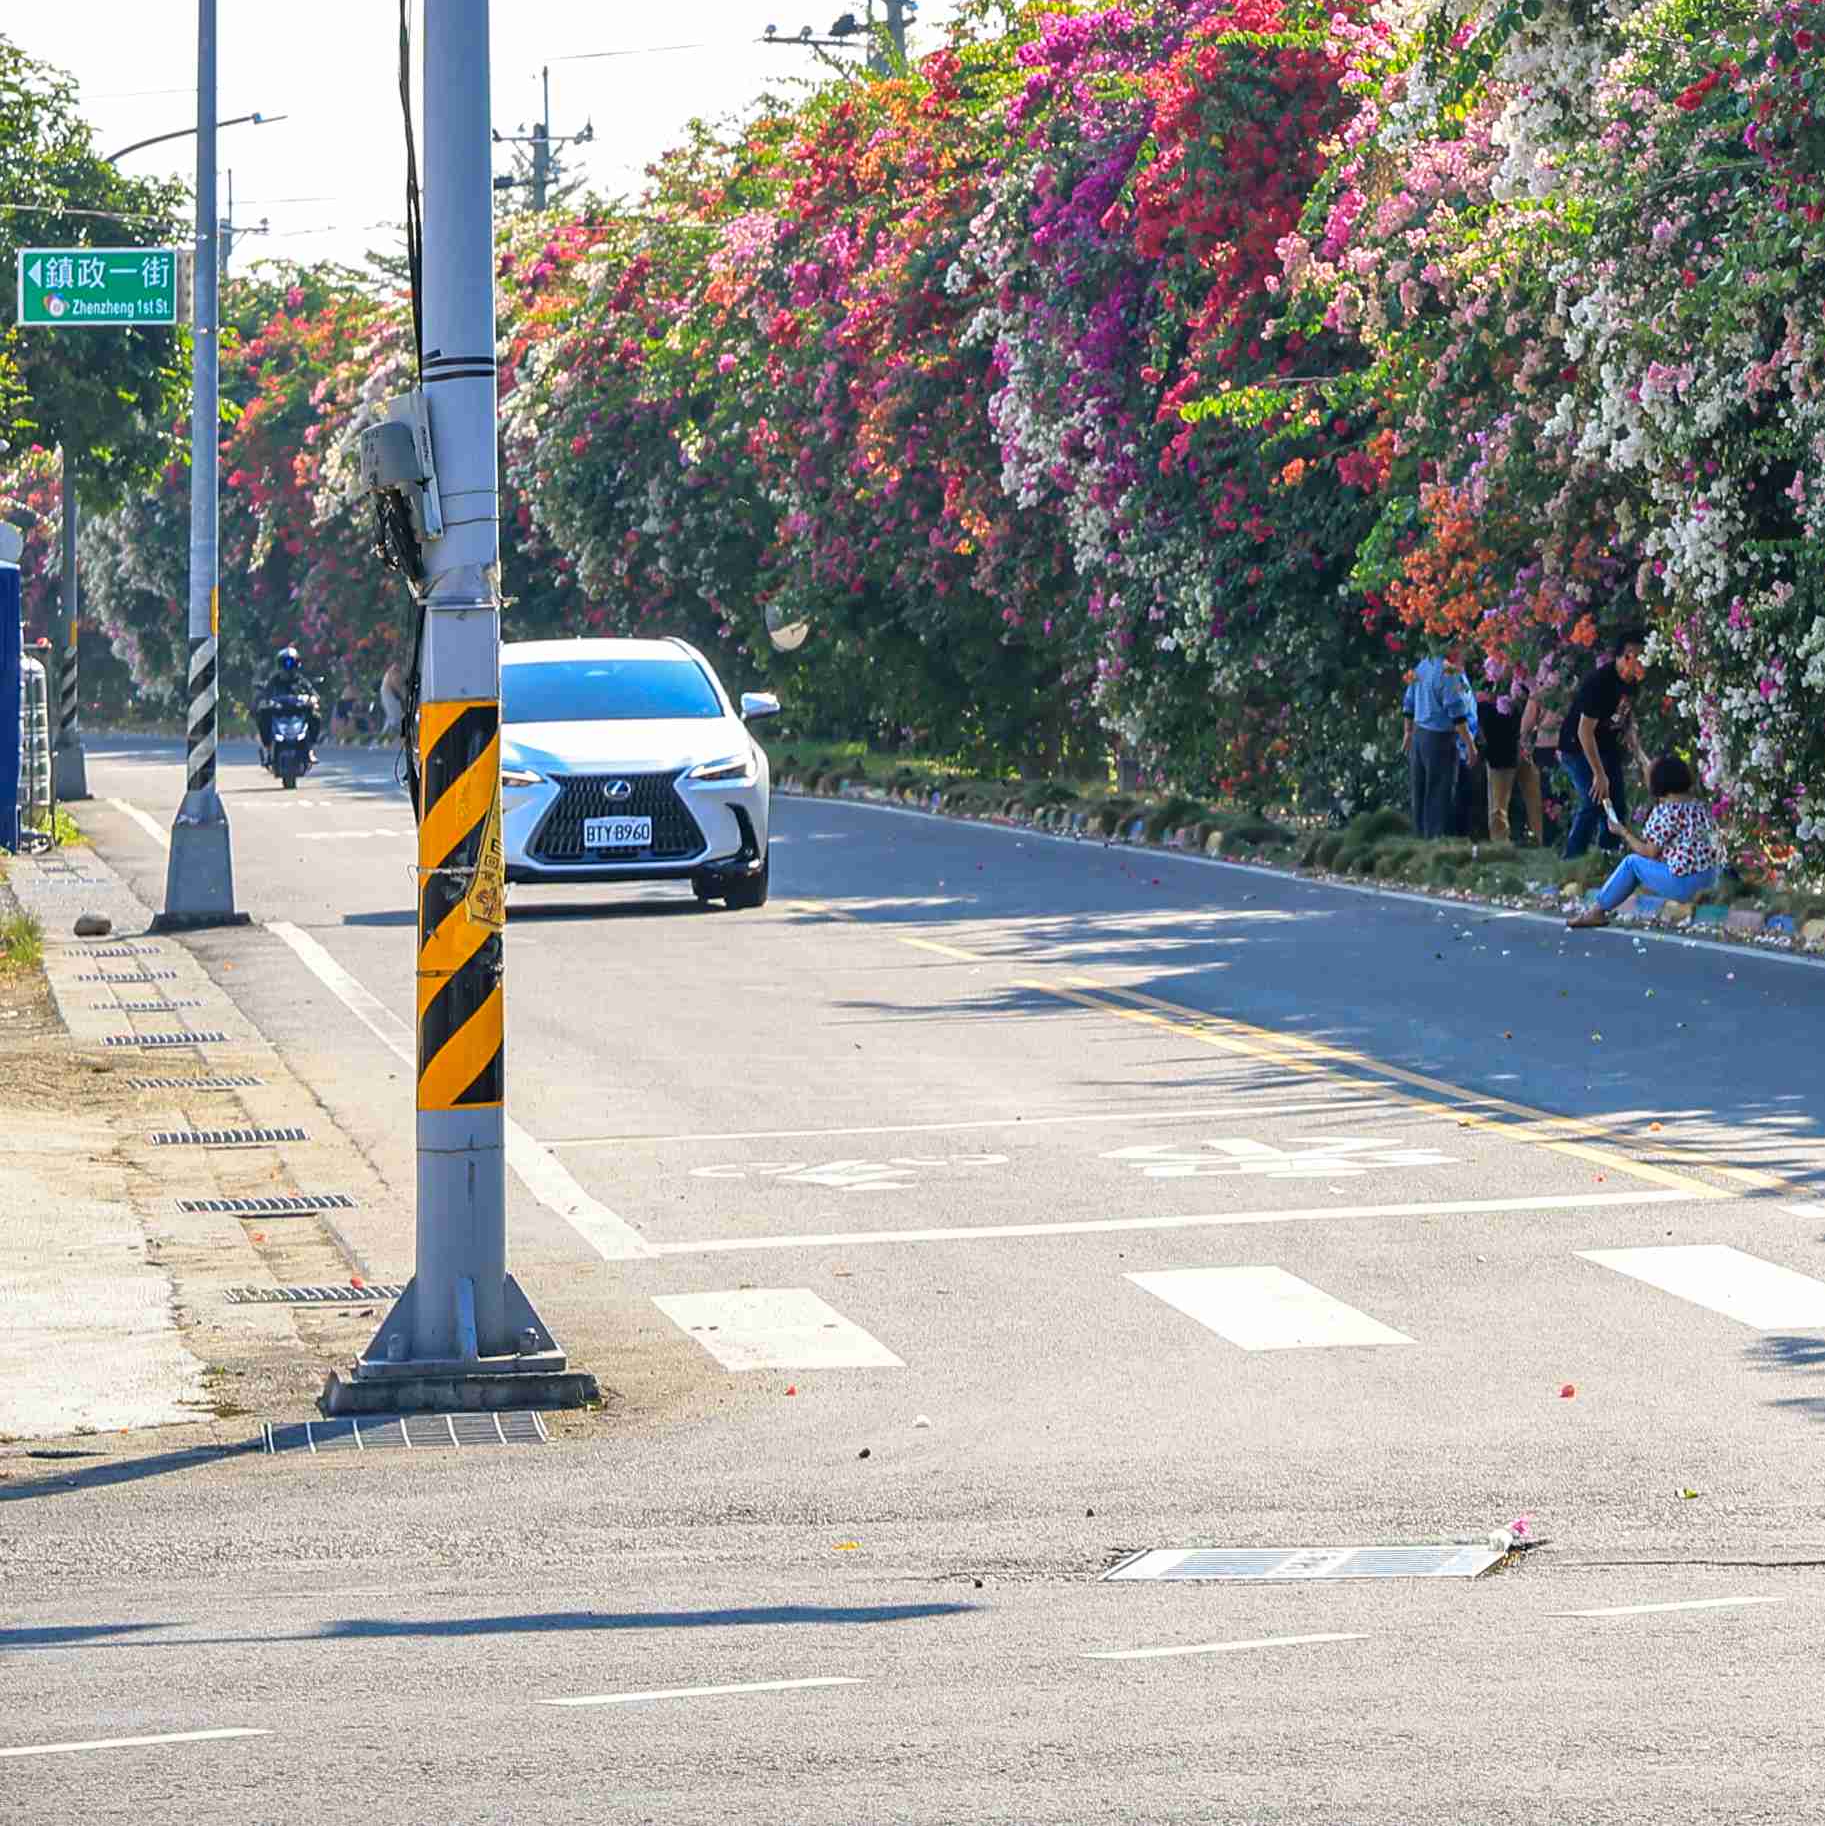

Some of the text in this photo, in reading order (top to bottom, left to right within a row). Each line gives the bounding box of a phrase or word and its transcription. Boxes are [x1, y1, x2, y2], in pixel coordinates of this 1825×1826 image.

[46, 256, 169, 289] 鎮政一街
[72, 298, 171, 318] Zhenzheng 1st St.
